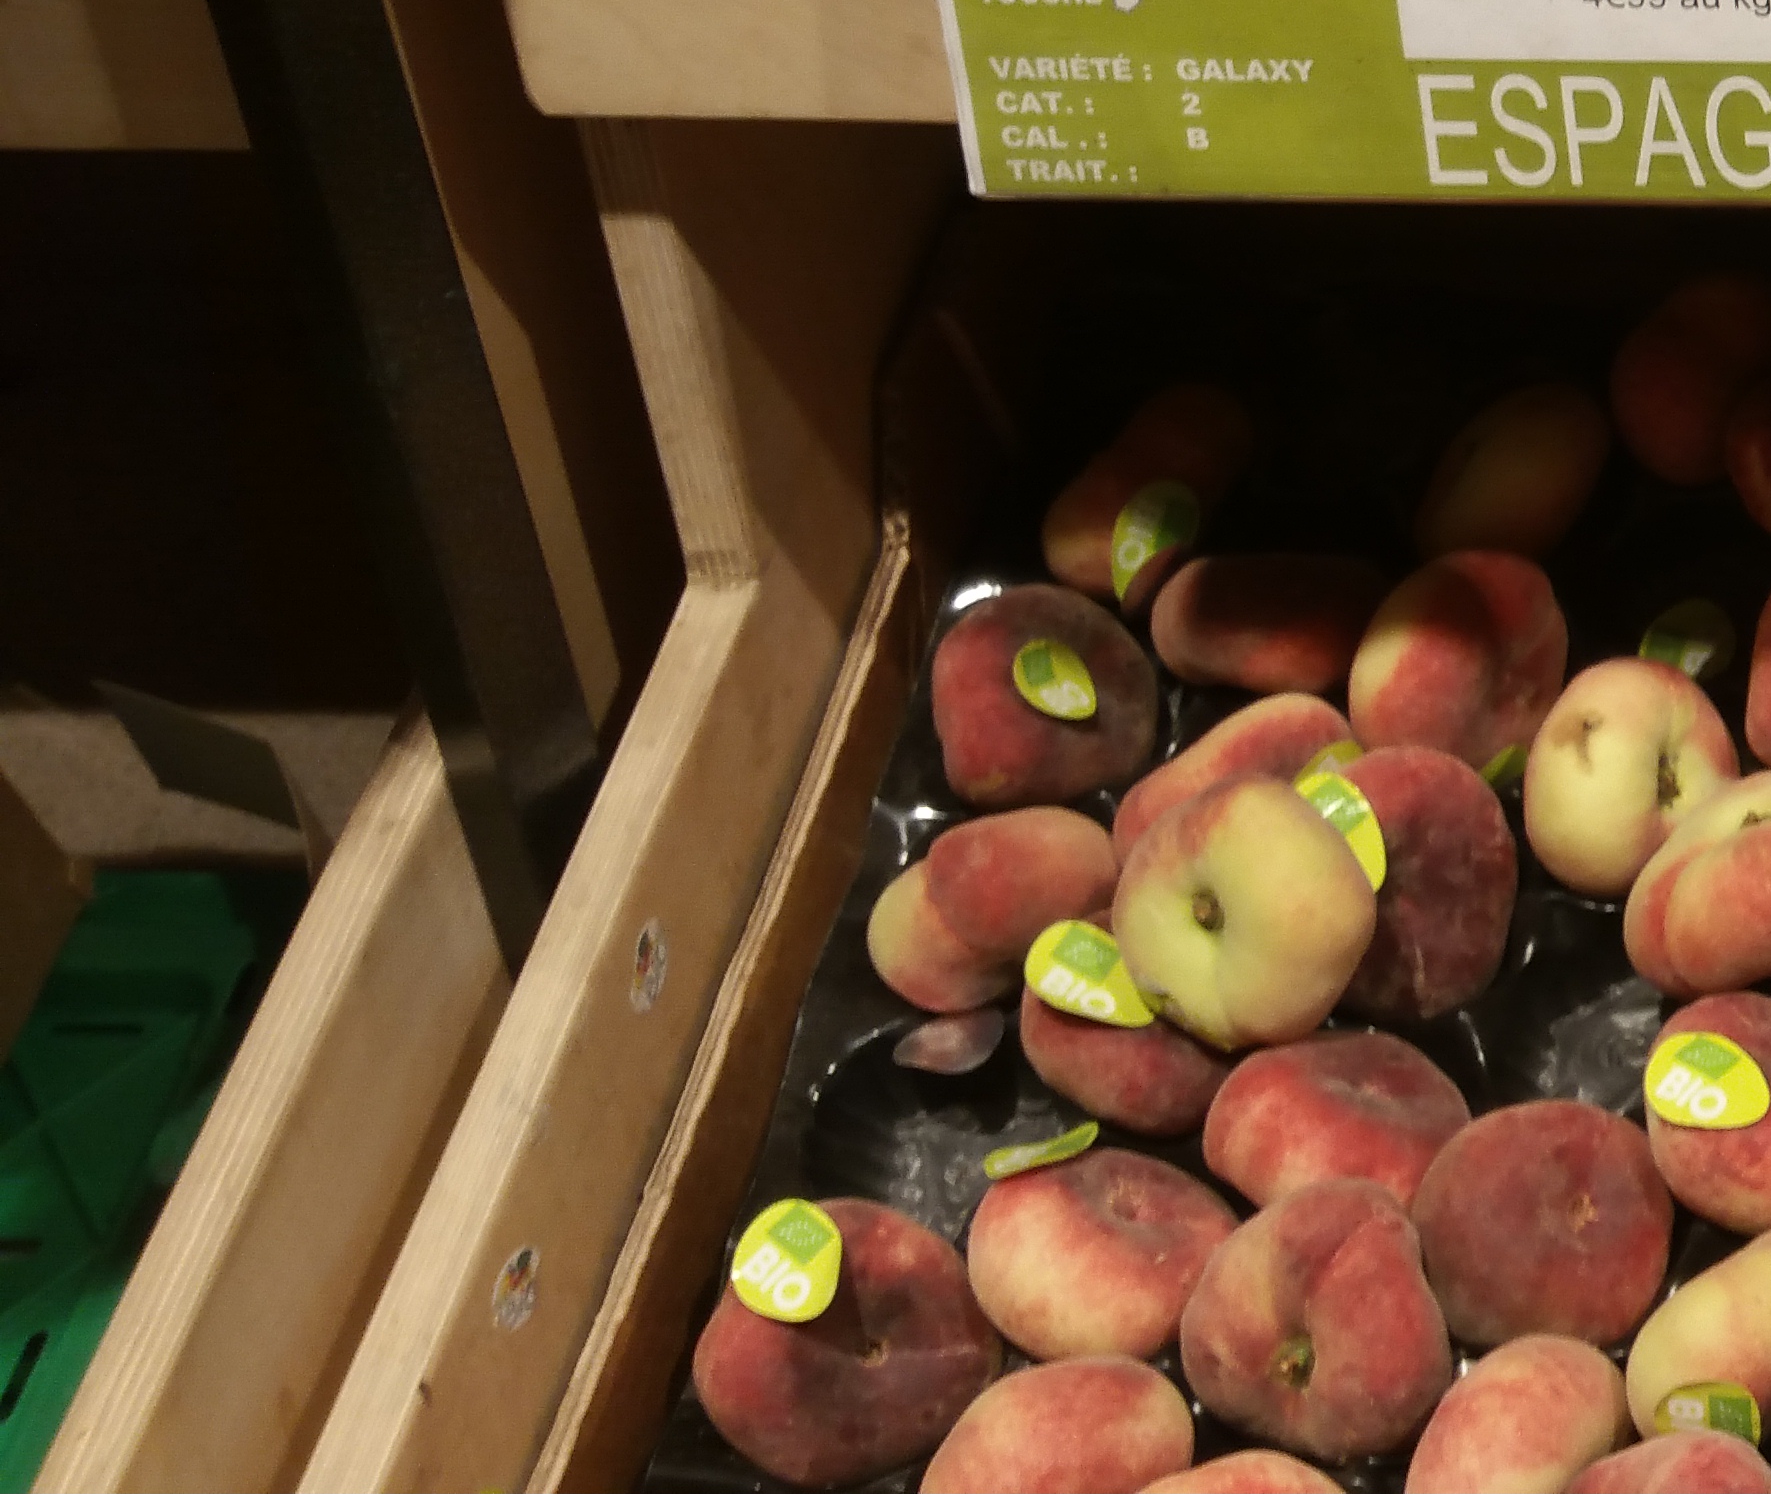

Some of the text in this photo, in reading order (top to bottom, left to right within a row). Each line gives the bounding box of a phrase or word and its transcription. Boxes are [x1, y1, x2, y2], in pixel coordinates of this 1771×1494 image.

[988, 53, 1134, 83] VARIÉTÉ
[1176, 58, 1314, 83] GALAXY
[996, 92, 1074, 115] CAT.
[1181, 92, 1203, 116] 2
[1186, 127, 1210, 151] B
[1006, 159, 1119, 183] TRAIT.
[1042, 966, 1118, 1018] BIO
[1655, 1065, 1728, 1122] BIO
[737, 1243, 811, 1309] BIO
